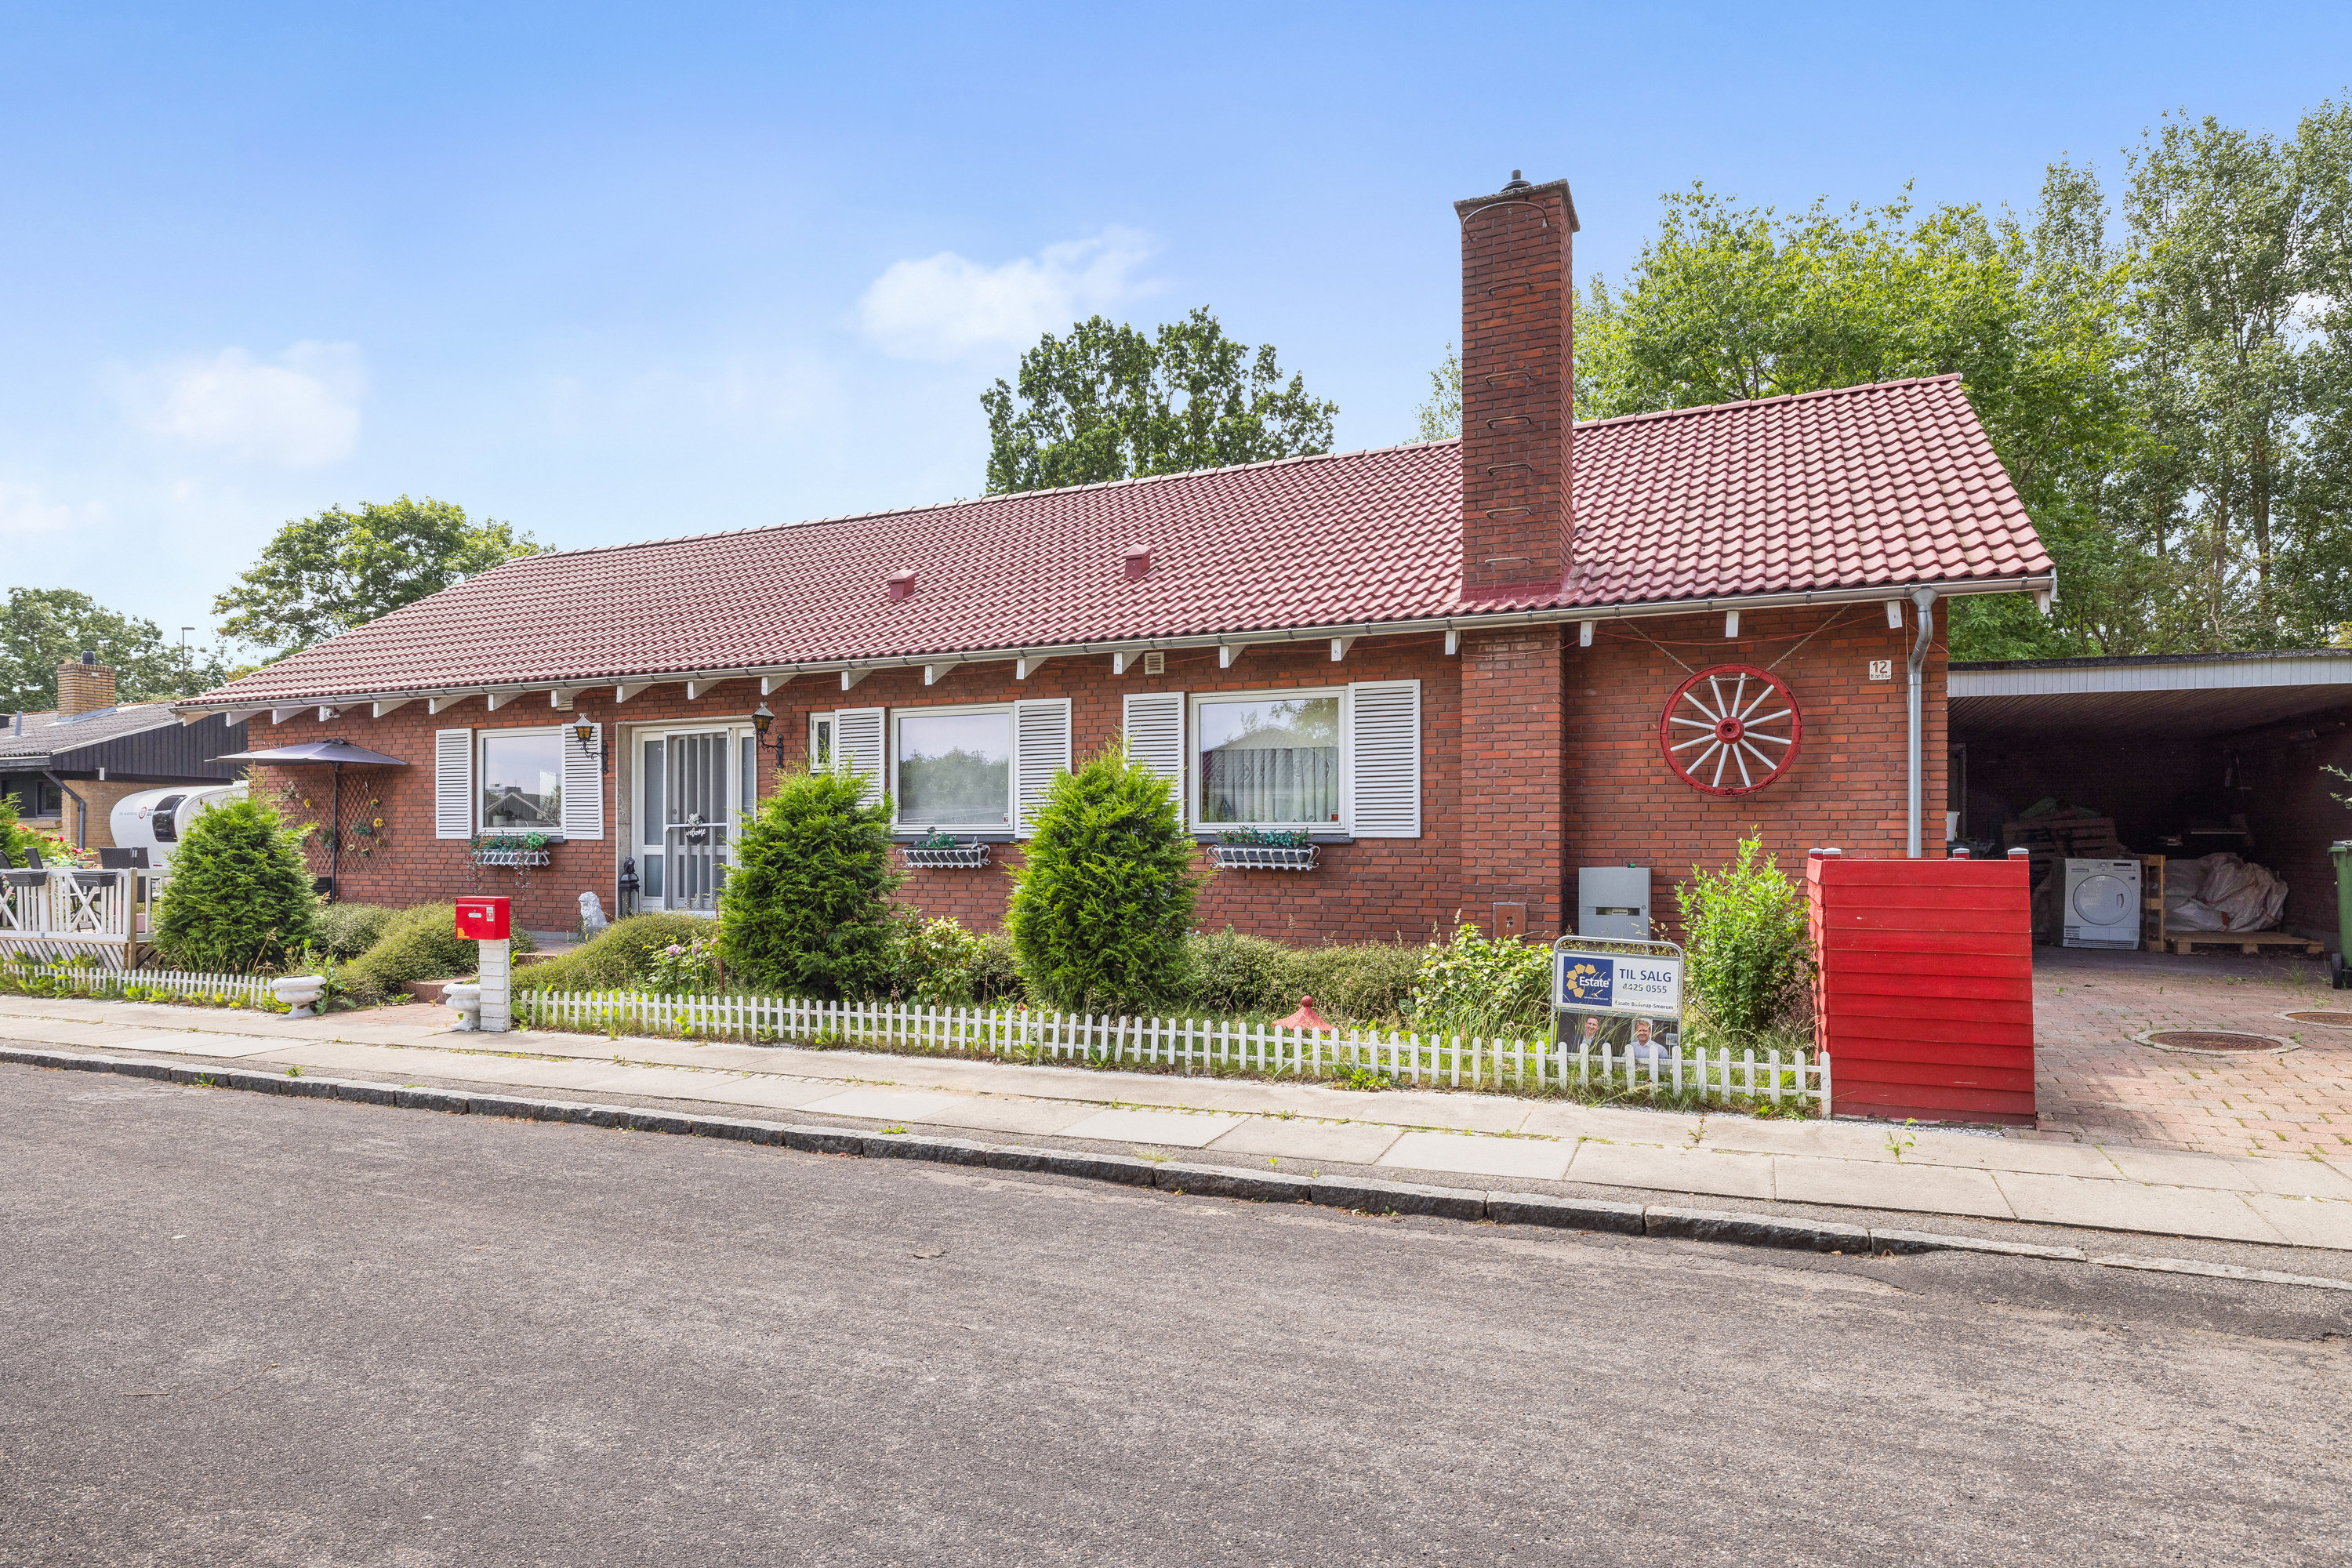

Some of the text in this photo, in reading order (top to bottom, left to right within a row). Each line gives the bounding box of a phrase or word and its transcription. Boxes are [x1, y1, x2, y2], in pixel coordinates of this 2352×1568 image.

[1873, 661, 1887, 673] 12
[1619, 968, 1671, 982] TIL SALG
[1579, 975, 1610, 988] Estate
[1622, 982, 1667, 993] 4425 0555
